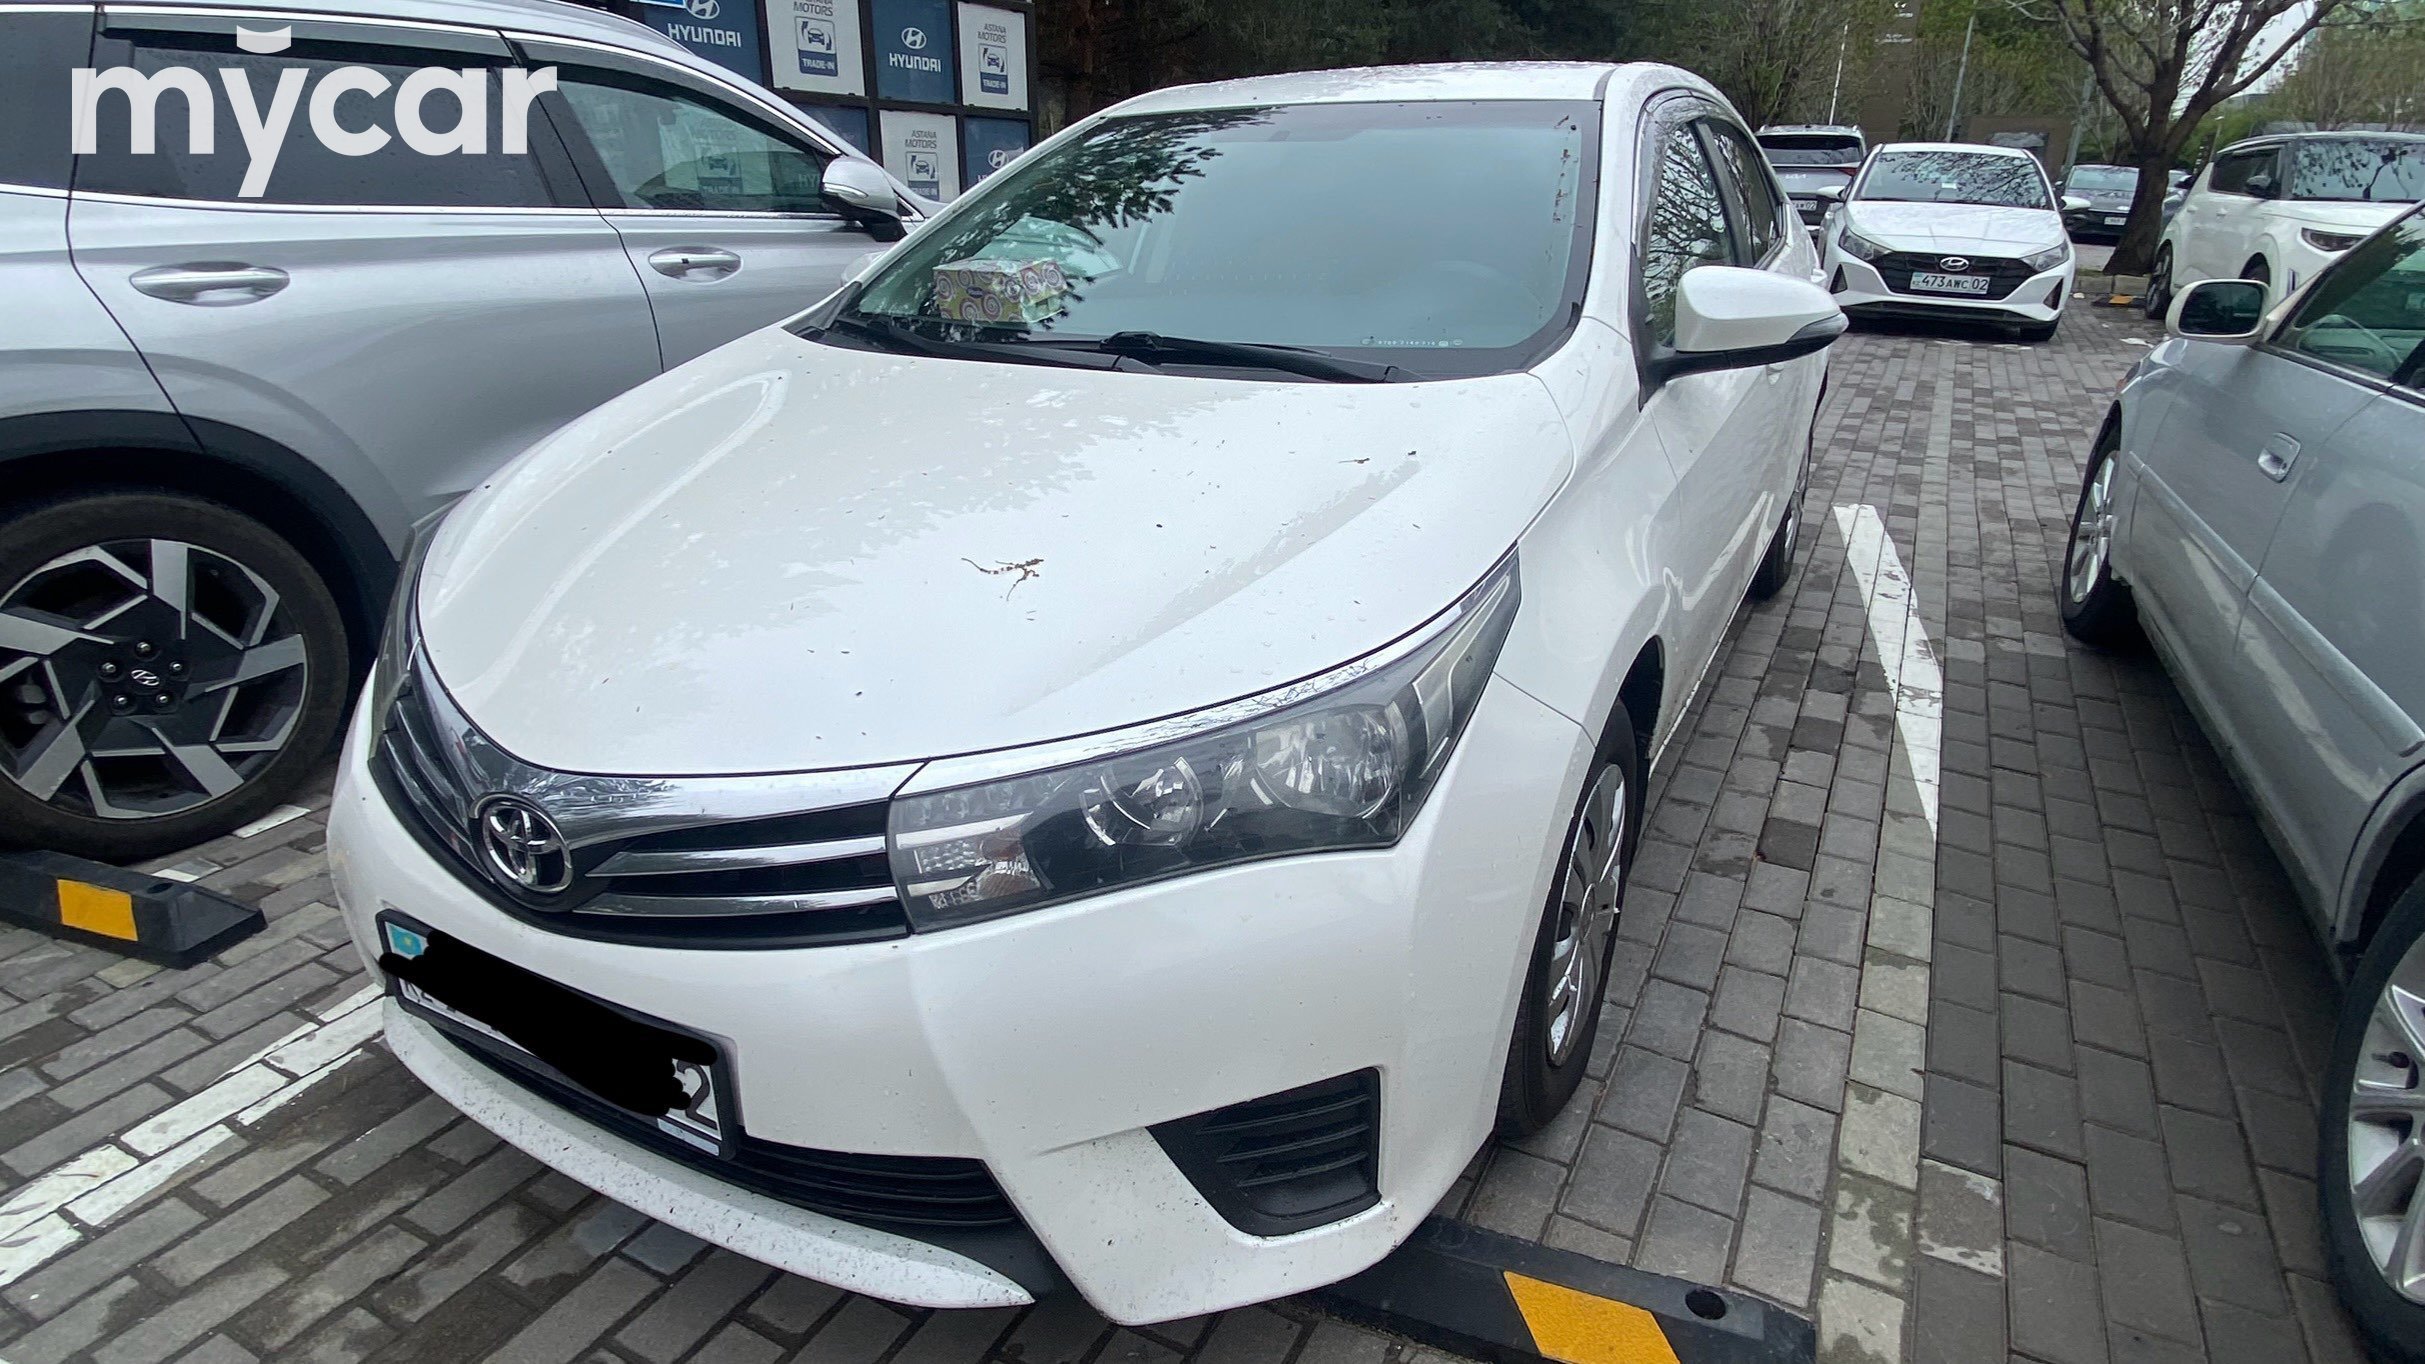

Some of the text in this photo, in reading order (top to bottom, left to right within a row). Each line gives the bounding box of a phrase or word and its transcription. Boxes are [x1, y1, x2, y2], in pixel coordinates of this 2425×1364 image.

[793, 1, 834, 16] MOTORS
[984, 23, 1006, 33] ASTANA
[667, 23, 742, 48] HYUNDAI
[977, 30, 1007, 43] MOTORS
[801, 58, 836, 70] TRADE-IN
[888, 53, 942, 73] HYUNDAI
[911, 130, 937, 139] ASTANA
[904, 138, 937, 149] MOTORS
[1922, 275, 1969, 289] 473AWC
[1971, 278, 1988, 290] 02
